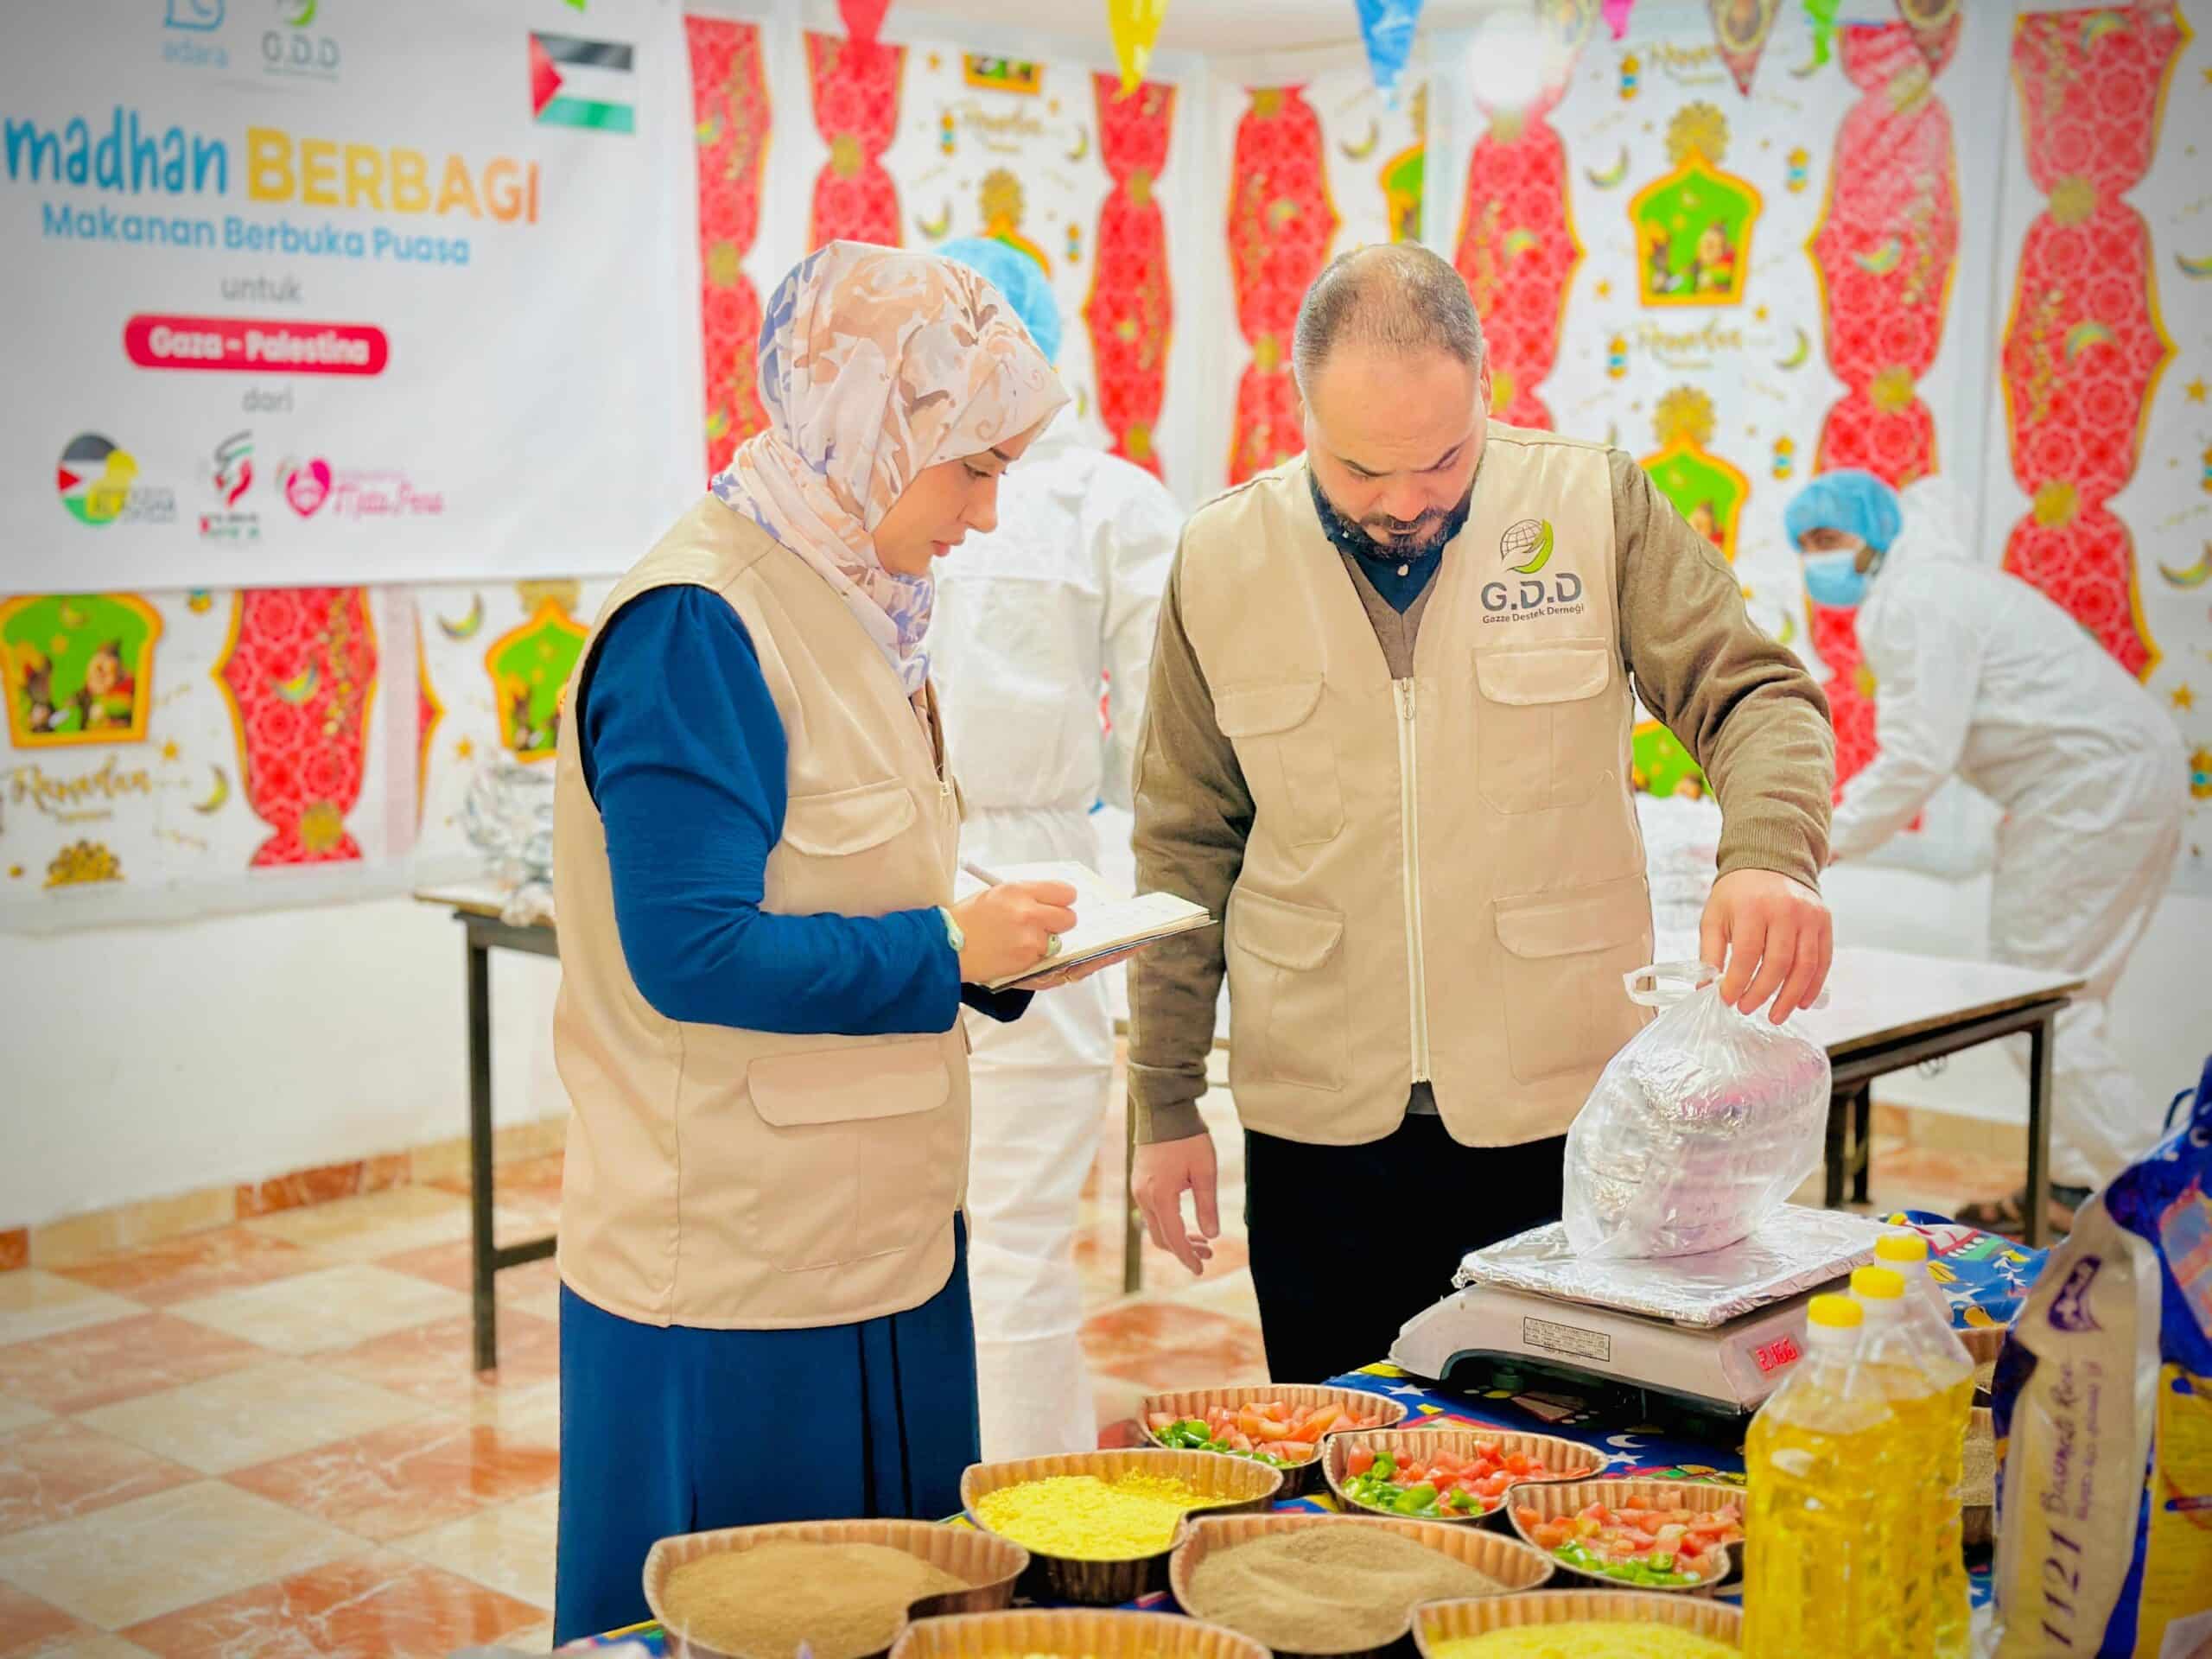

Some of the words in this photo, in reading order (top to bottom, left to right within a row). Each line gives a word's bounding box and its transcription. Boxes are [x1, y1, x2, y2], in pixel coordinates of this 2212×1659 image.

[4, 104, 228, 195] madhan
[247, 125, 539, 226] BERBAGI
[41, 202, 216, 247] Makanan
[223, 214, 366, 257] Berbuka
[372, 225, 470, 265] Puasa
[221, 273, 301, 302] untuk
[149, 325, 224, 359] Gaza
[245, 328, 370, 365] Palestina
[241, 386, 294, 412] dari
[1481, 573, 1581, 612] G.D.D
[1482, 614, 1510, 624] Gazze
[1512, 608, 1545, 621] Destek
[2040, 1526, 2082, 1649] 1121
